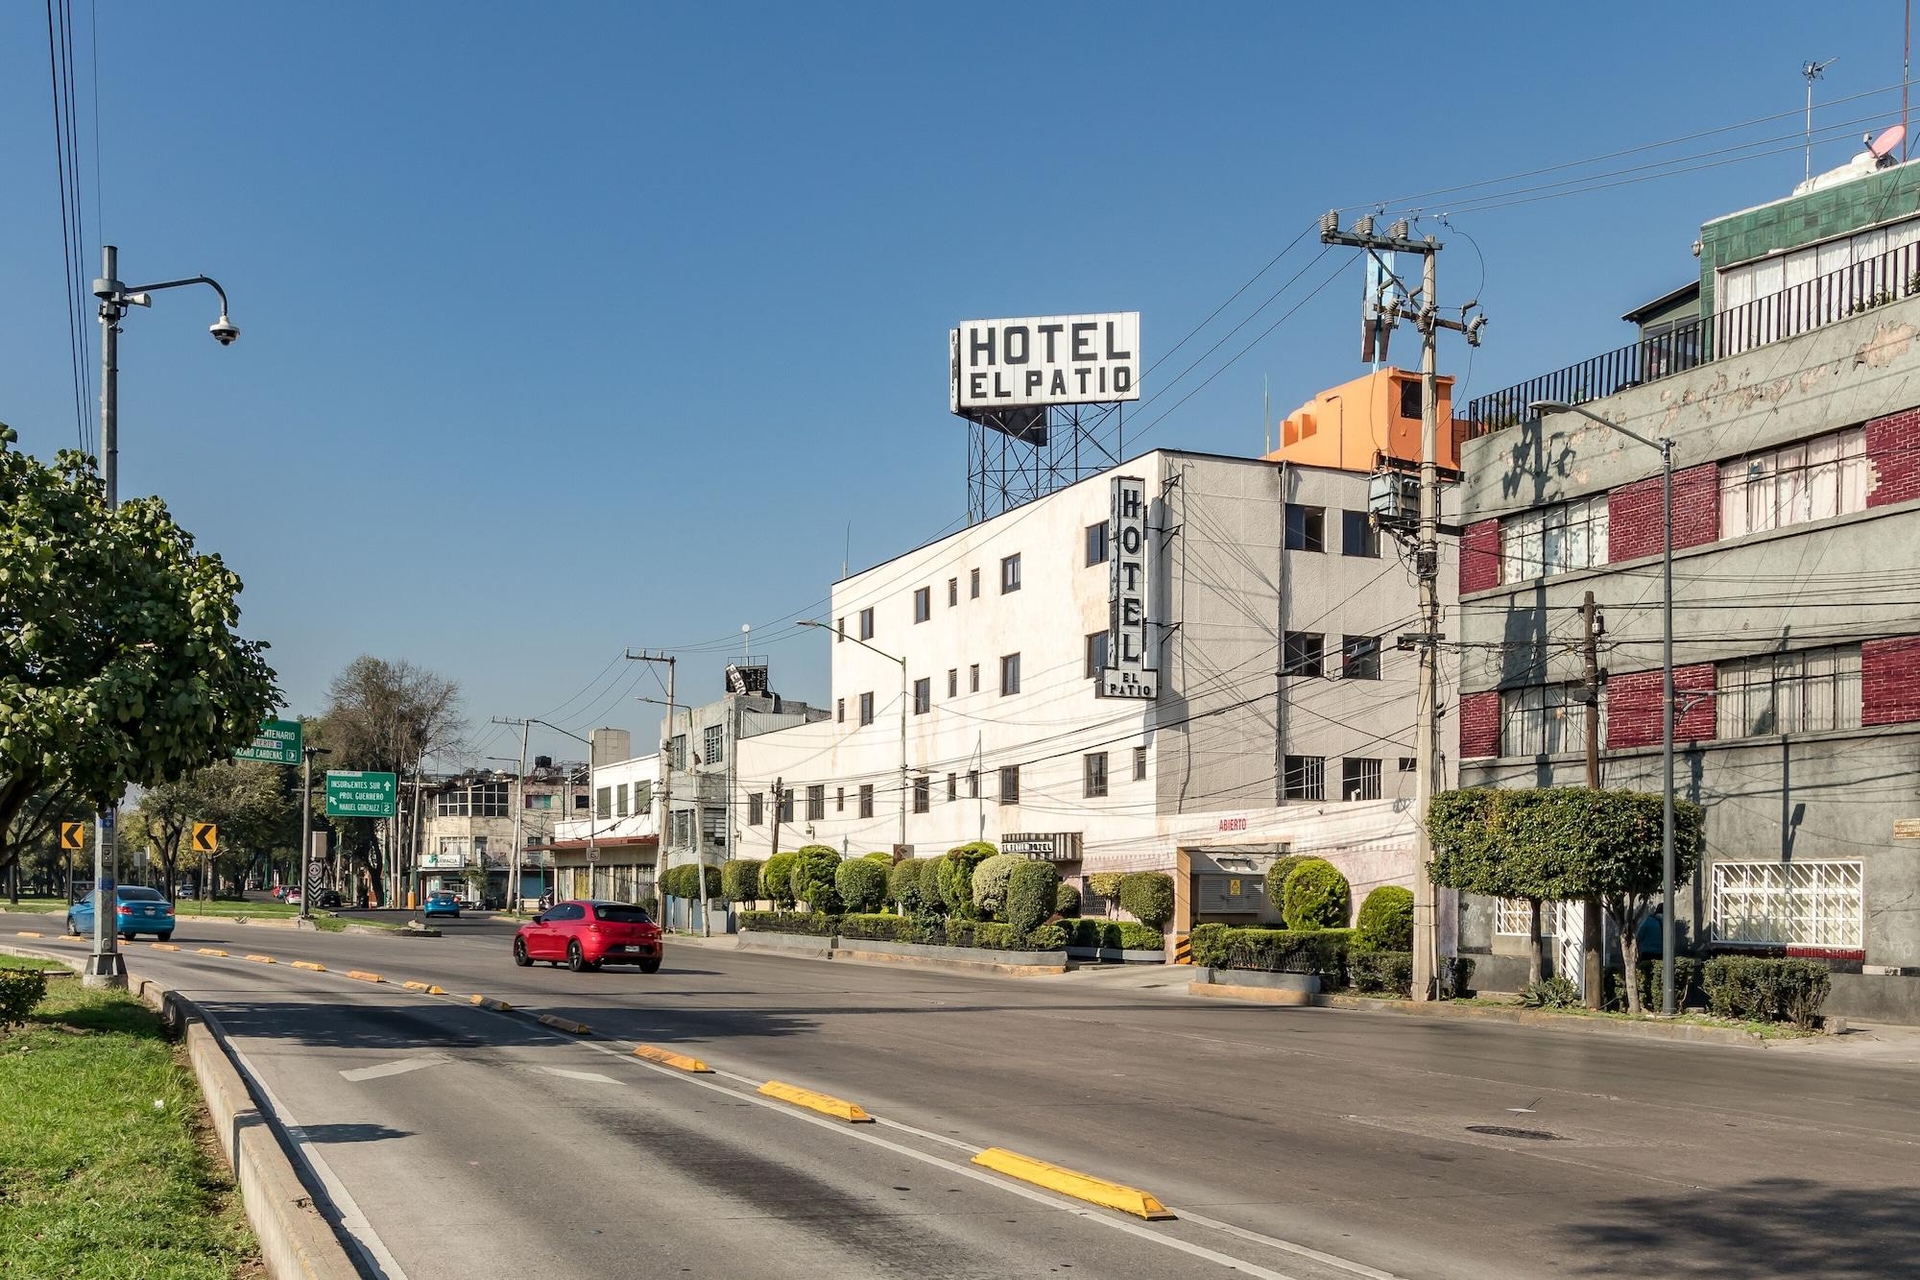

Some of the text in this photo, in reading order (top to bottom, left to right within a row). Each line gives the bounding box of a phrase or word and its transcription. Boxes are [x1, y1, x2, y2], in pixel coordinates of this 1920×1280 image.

[970, 321, 1131, 366] HOTEL
[970, 365, 1131, 399] EL PATIO
[1122, 489, 1141, 663] HOTEL
[1110, 672, 1151, 696] EL PATIO
[257, 729, 296, 741] NTENARIO
[235, 747, 283, 760] AZARO CARDENAS
[330, 780, 381, 790] INSURGENTES SUR
[355, 792, 384, 801] GUERRERO
[357, 803, 380, 812] GONZALEZ
[383, 804, 390, 812] 2
[1218, 818, 1247, 832] ABIERTO
[1028, 843, 1052, 851] HOTEL
